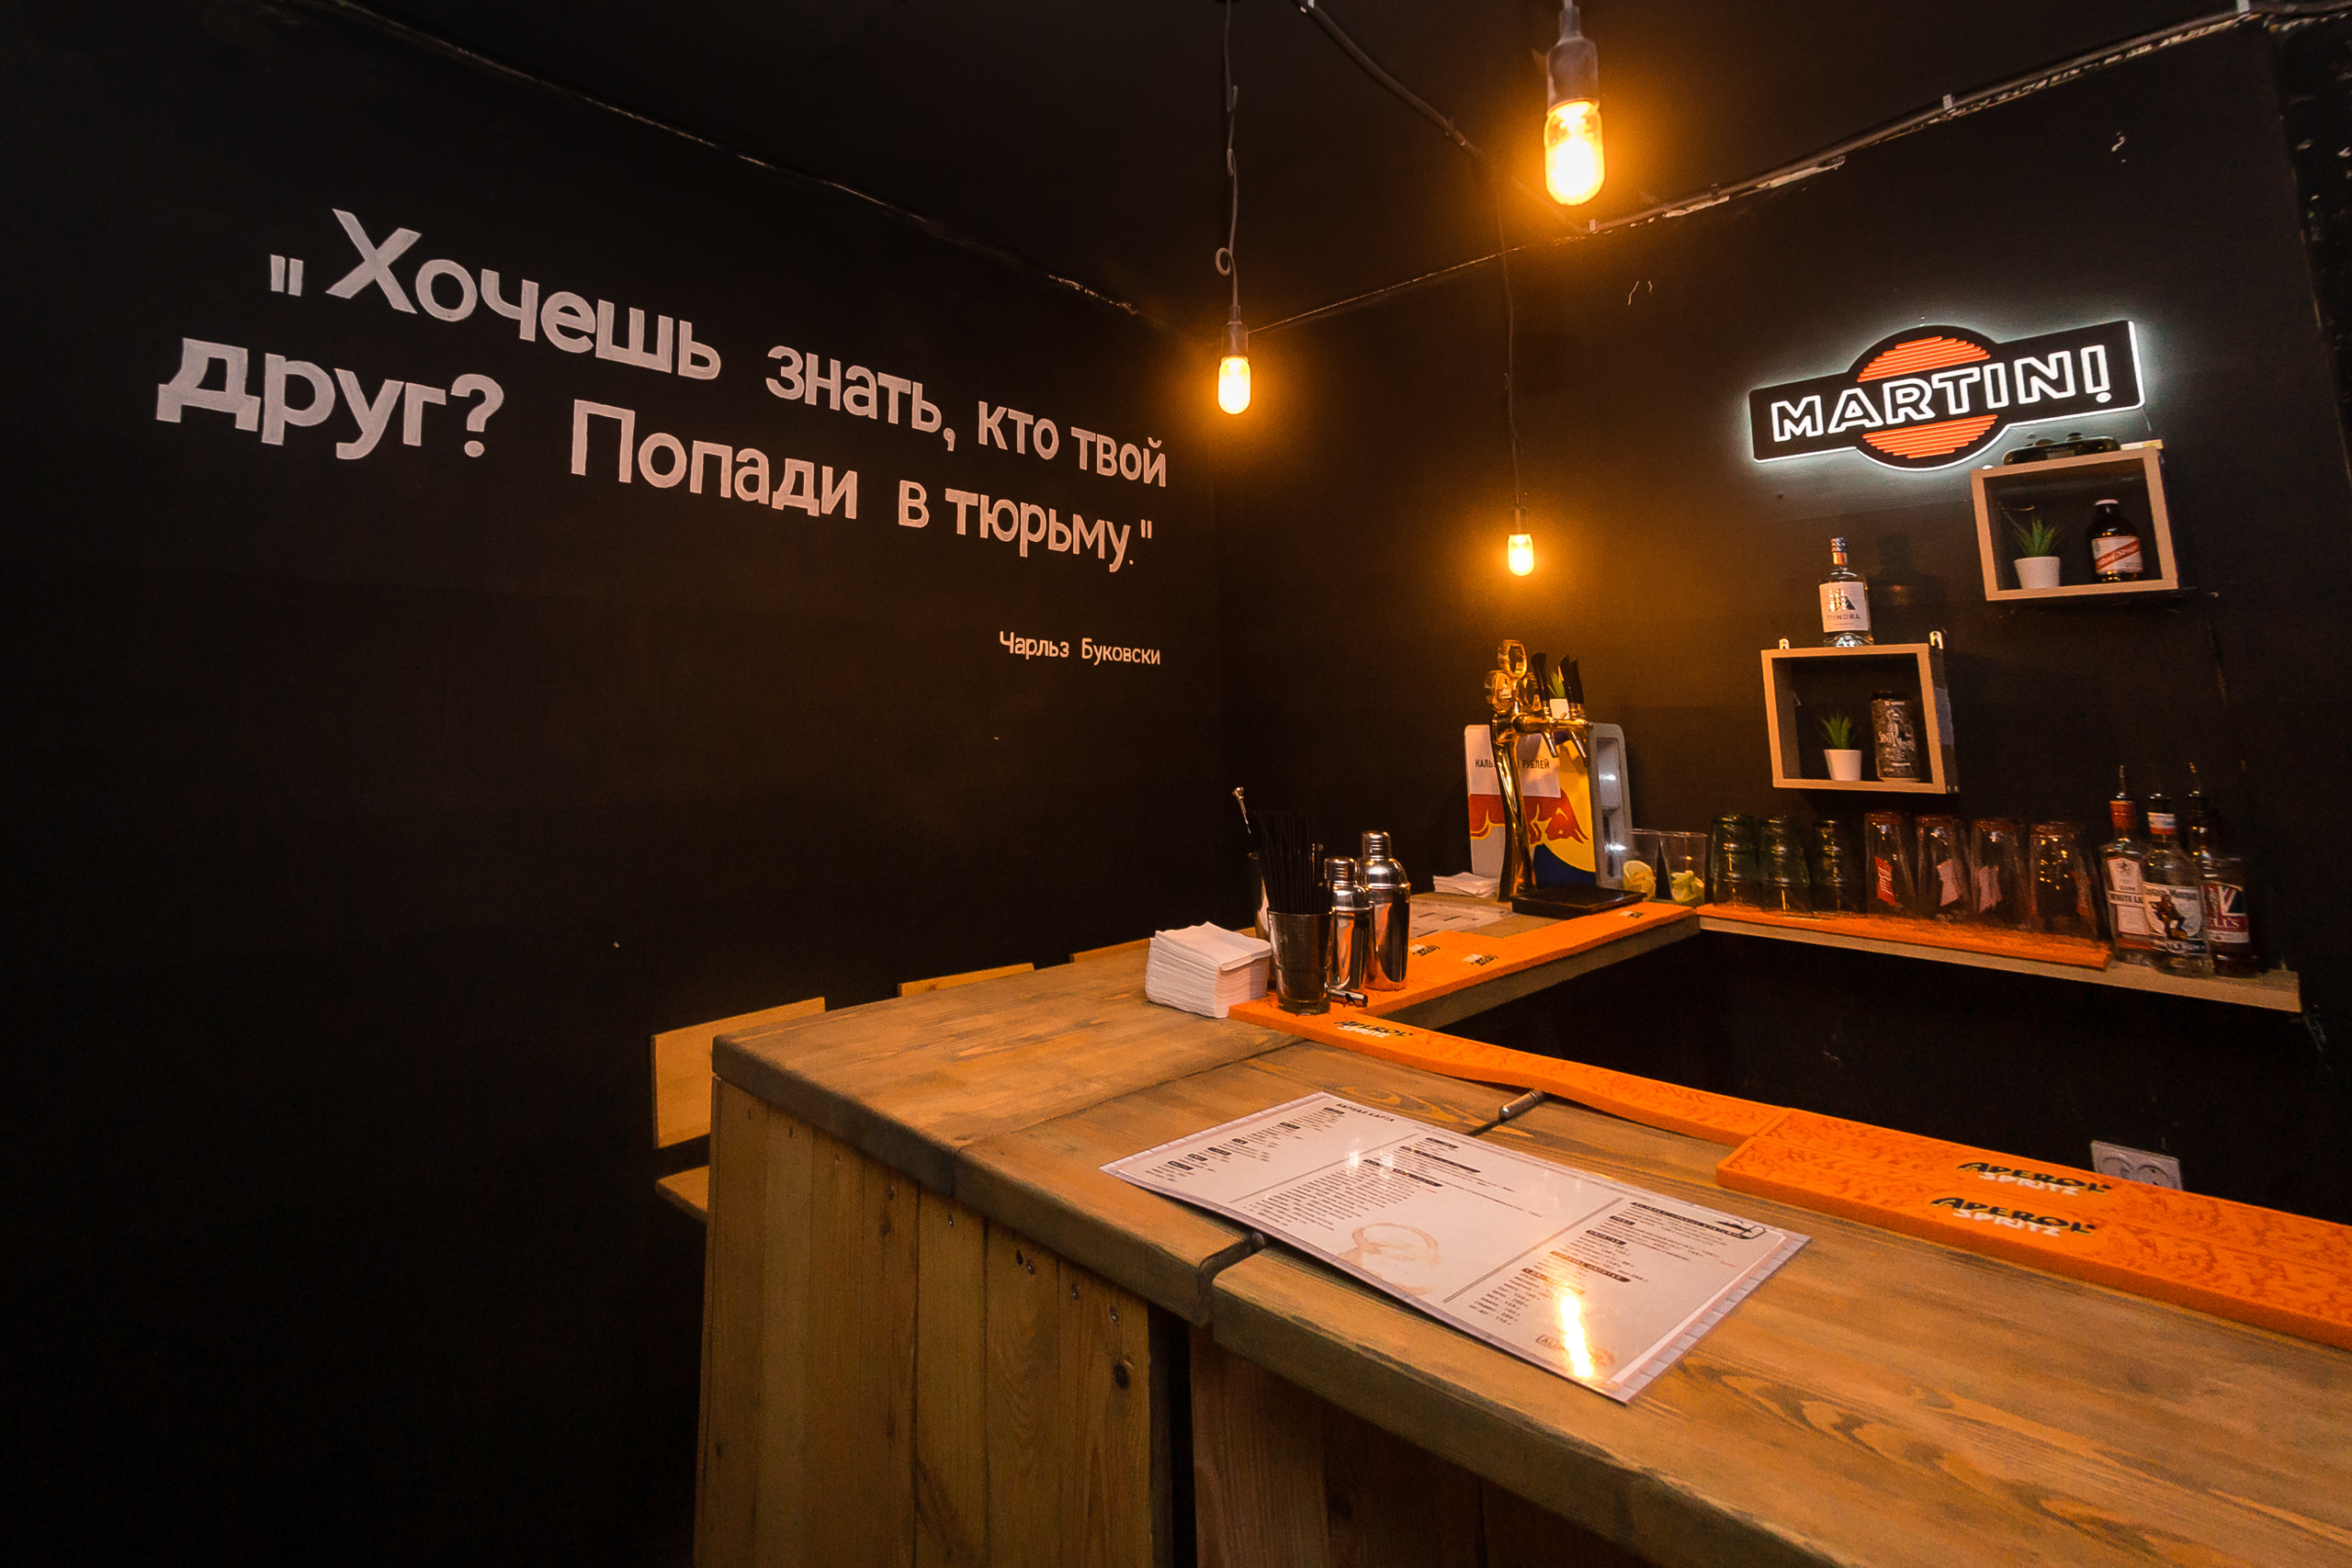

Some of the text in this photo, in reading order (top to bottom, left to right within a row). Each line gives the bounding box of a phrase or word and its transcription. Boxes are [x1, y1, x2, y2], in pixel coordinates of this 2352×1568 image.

[766, 345, 956, 451] знать,
[978, 401, 1058, 459] кто
[1071, 427, 1166, 487] твой
[156, 338, 1152, 572] друг? Попади в тюрьму."
[1000, 631, 1159, 665] Чарльз Буковски
[1475, 759, 1550, 769] КАЛЬ РУБЛЕЙ
[1957, 1162, 2109, 1195] APEROL
[1978, 1172, 2080, 1196] SPRITZ
[1930, 1197, 2093, 1235] APEROL
[1952, 1209, 2062, 1237] SPRITZ
